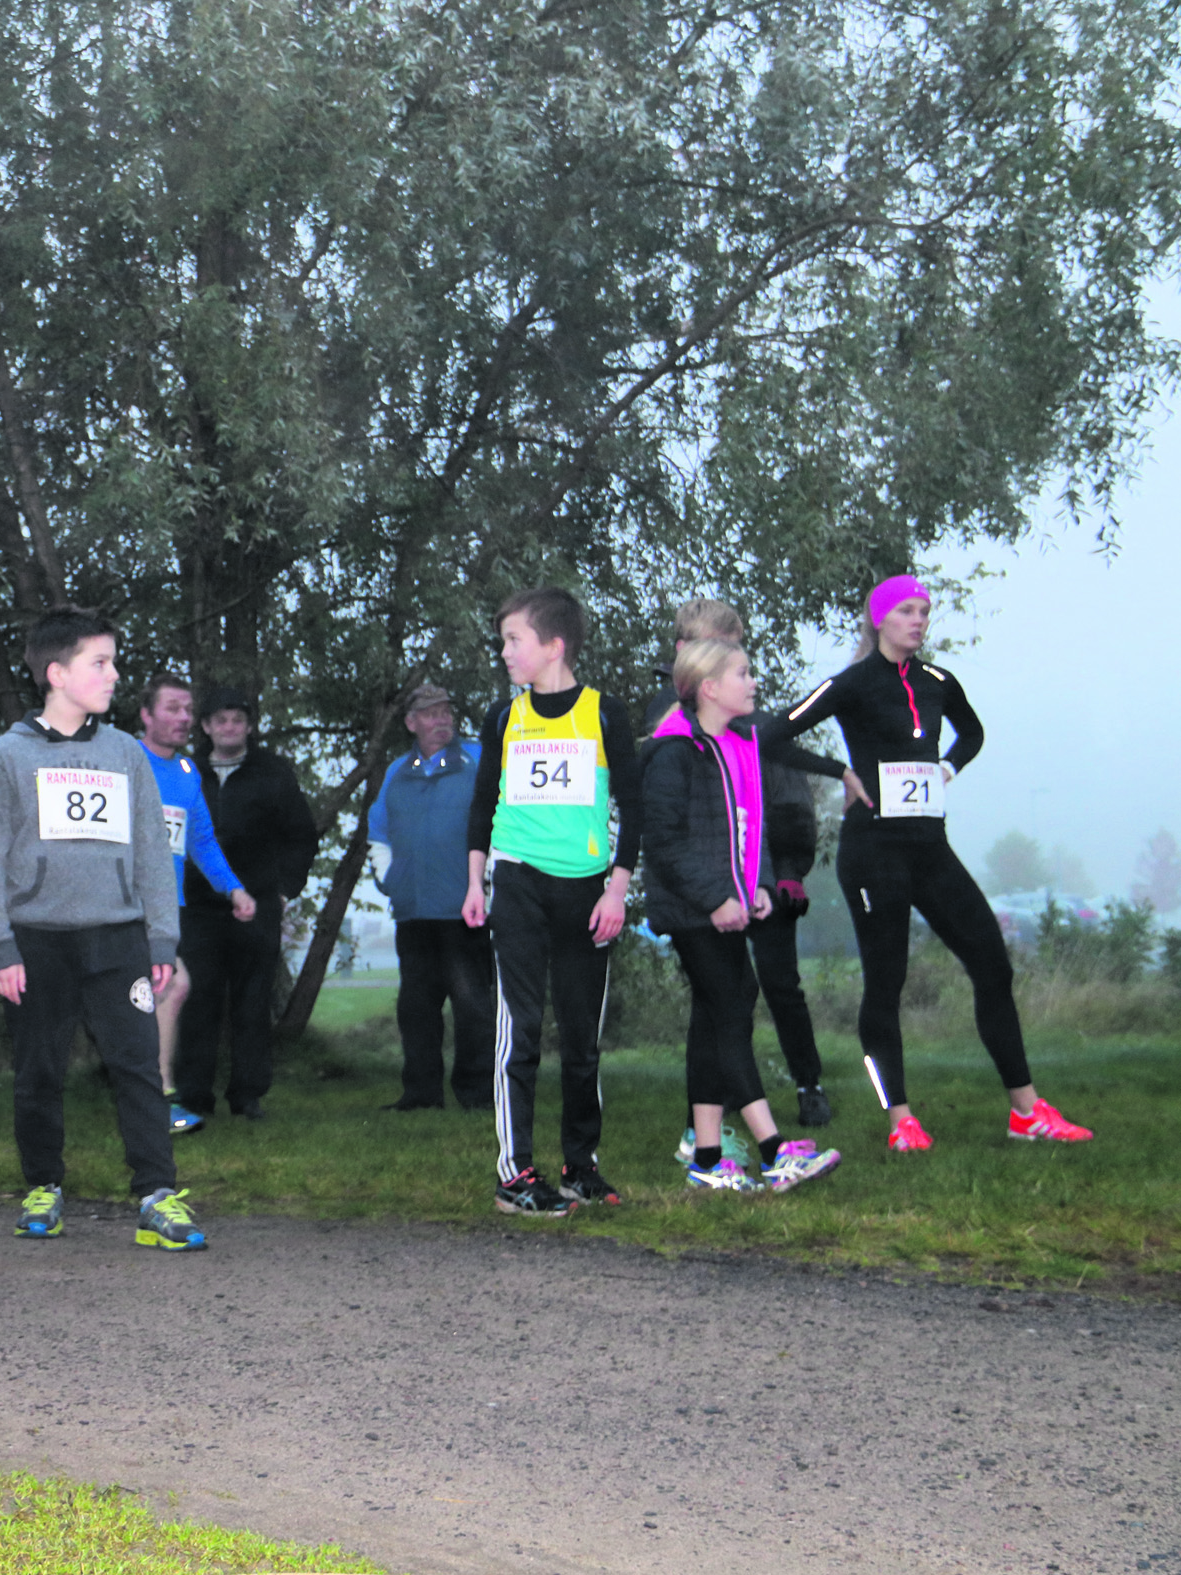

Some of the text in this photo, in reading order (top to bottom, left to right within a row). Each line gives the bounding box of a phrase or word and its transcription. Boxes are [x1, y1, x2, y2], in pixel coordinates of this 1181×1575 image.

[514, 743, 579, 756] RANTALAKEUS
[46, 772, 114, 788] RANTALAKEUS
[530, 759, 571, 788] 54
[901, 779, 929, 803] 21
[66, 791, 108, 823] 82
